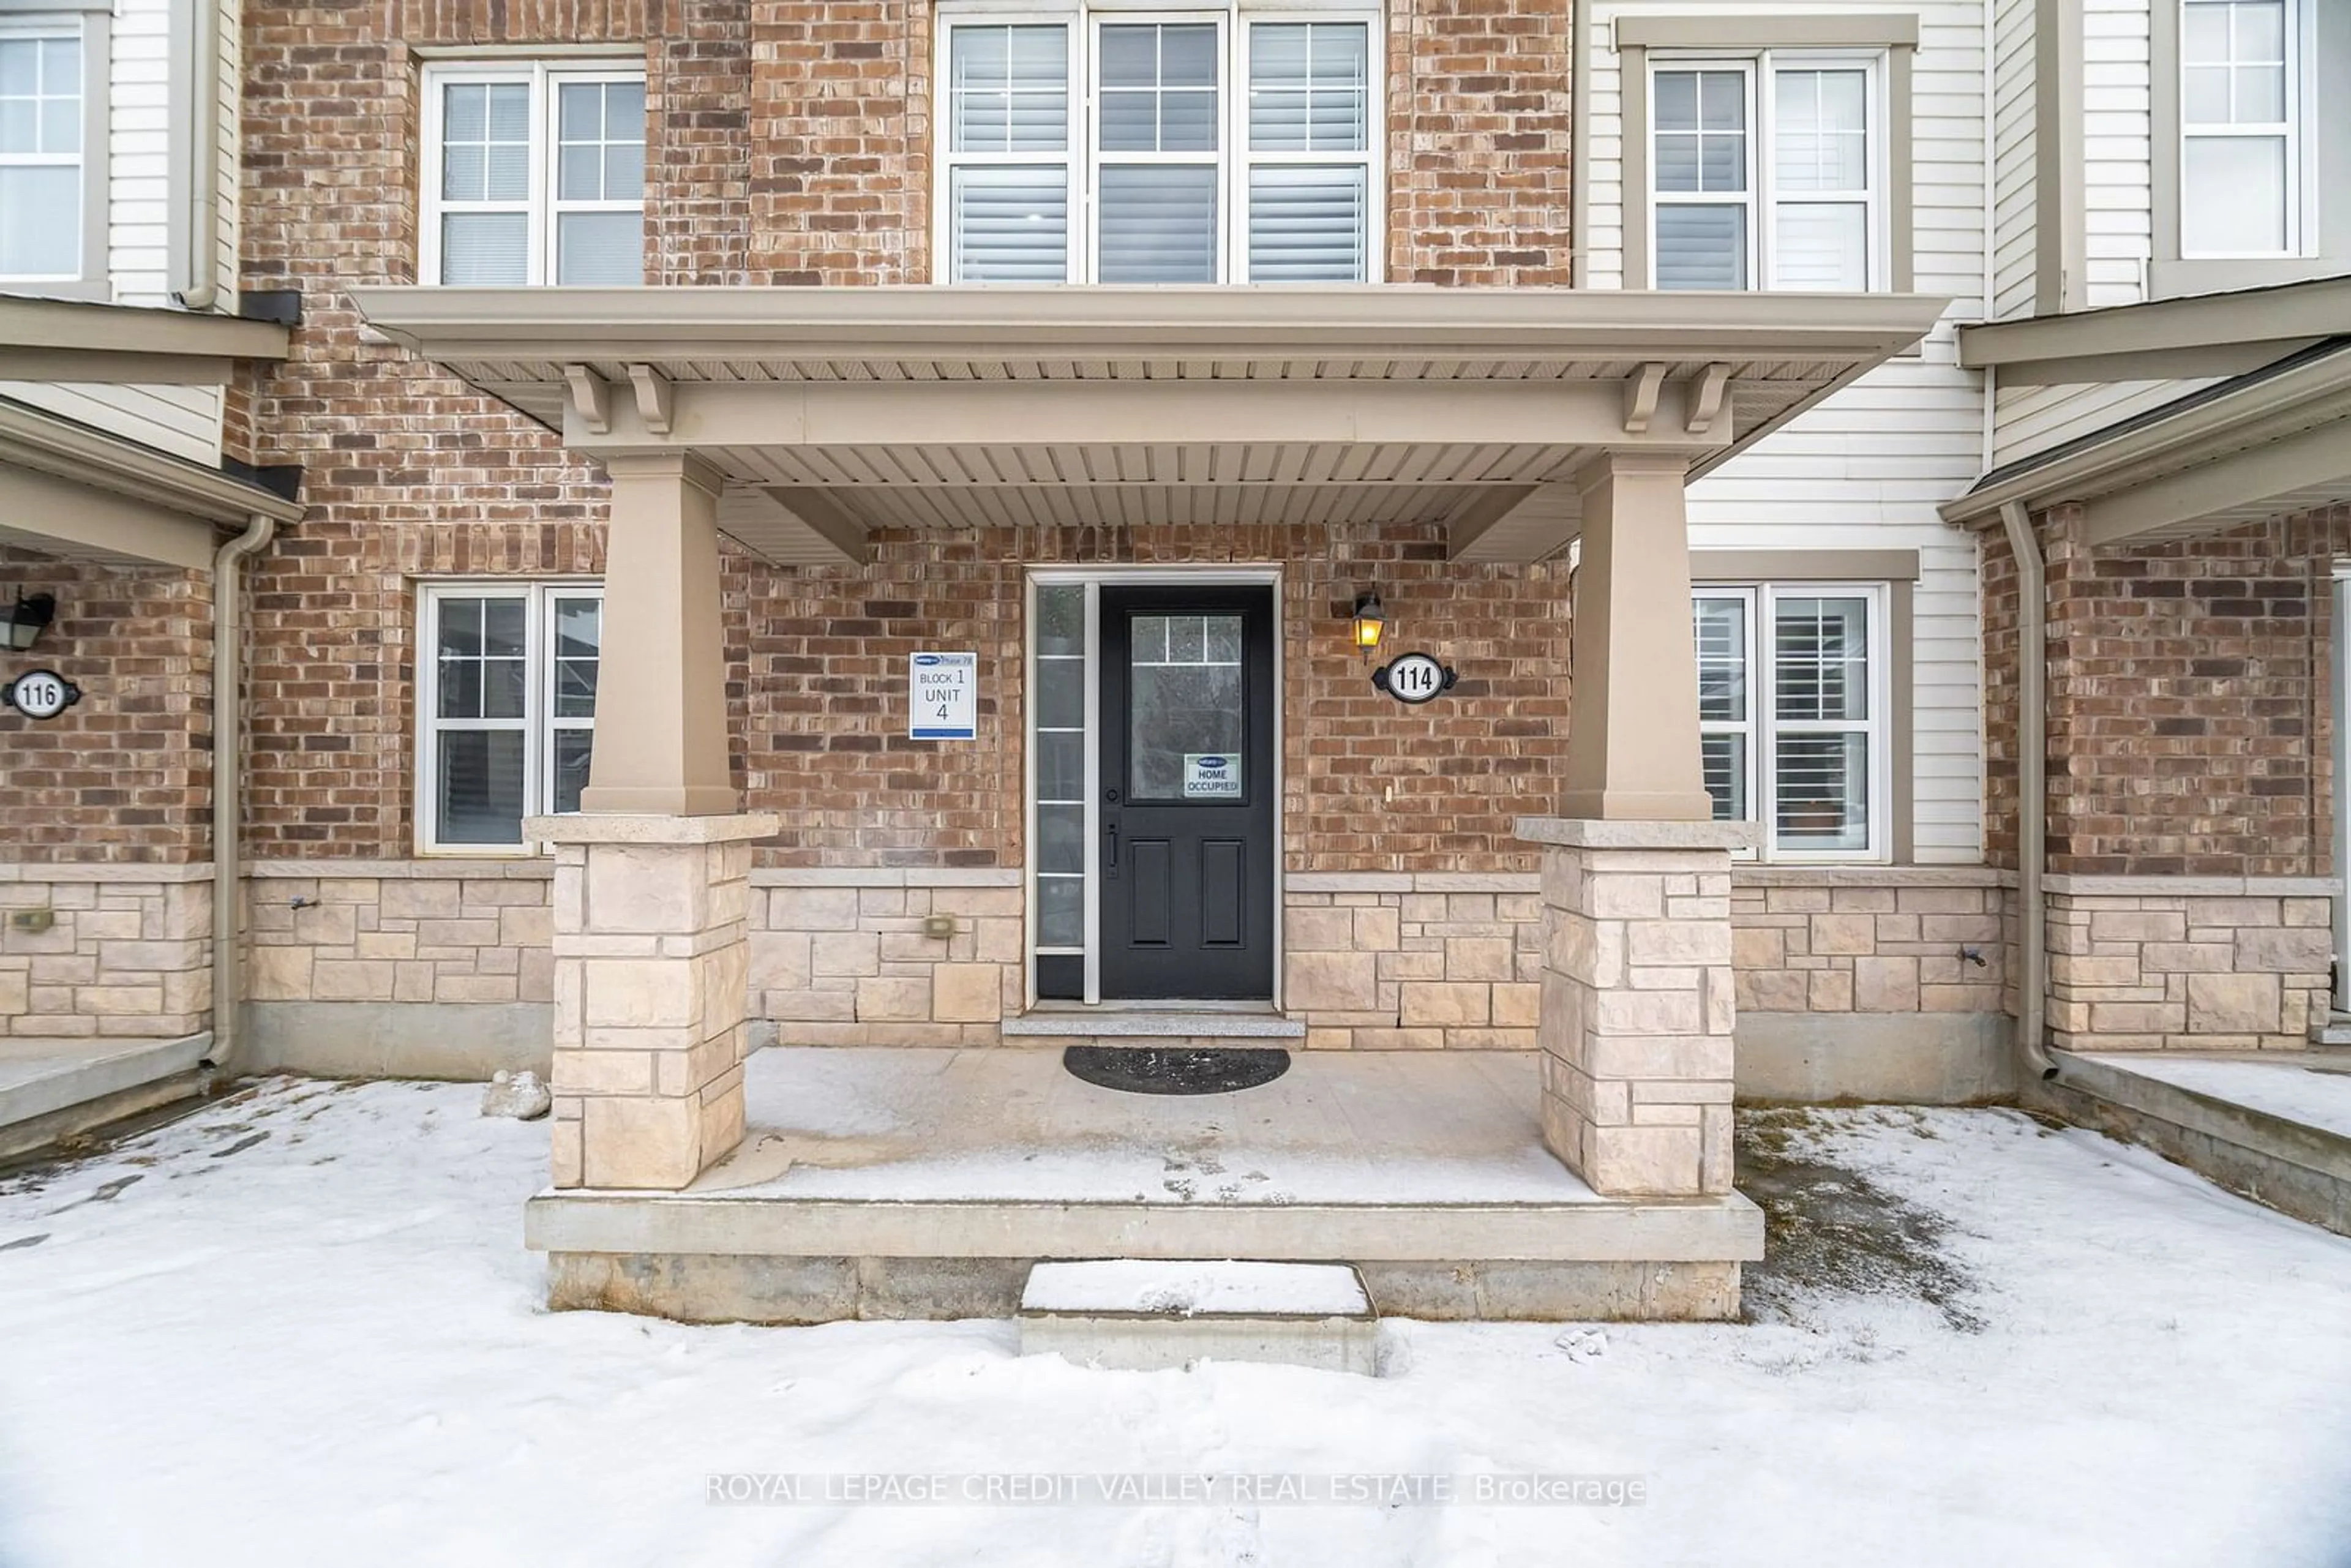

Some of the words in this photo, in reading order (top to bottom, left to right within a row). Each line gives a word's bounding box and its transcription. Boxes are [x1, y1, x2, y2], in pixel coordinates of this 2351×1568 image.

[920, 673, 953, 684] BLOCK
[957, 669, 964, 684] 1
[1398, 667, 1432, 689] 114
[23, 683, 56, 705] 116
[925, 689, 961, 702] UNIT
[936, 704, 948, 721] 4
[1198, 770, 1227, 779] HOME
[1188, 781, 1237, 791] OCCUPIED
